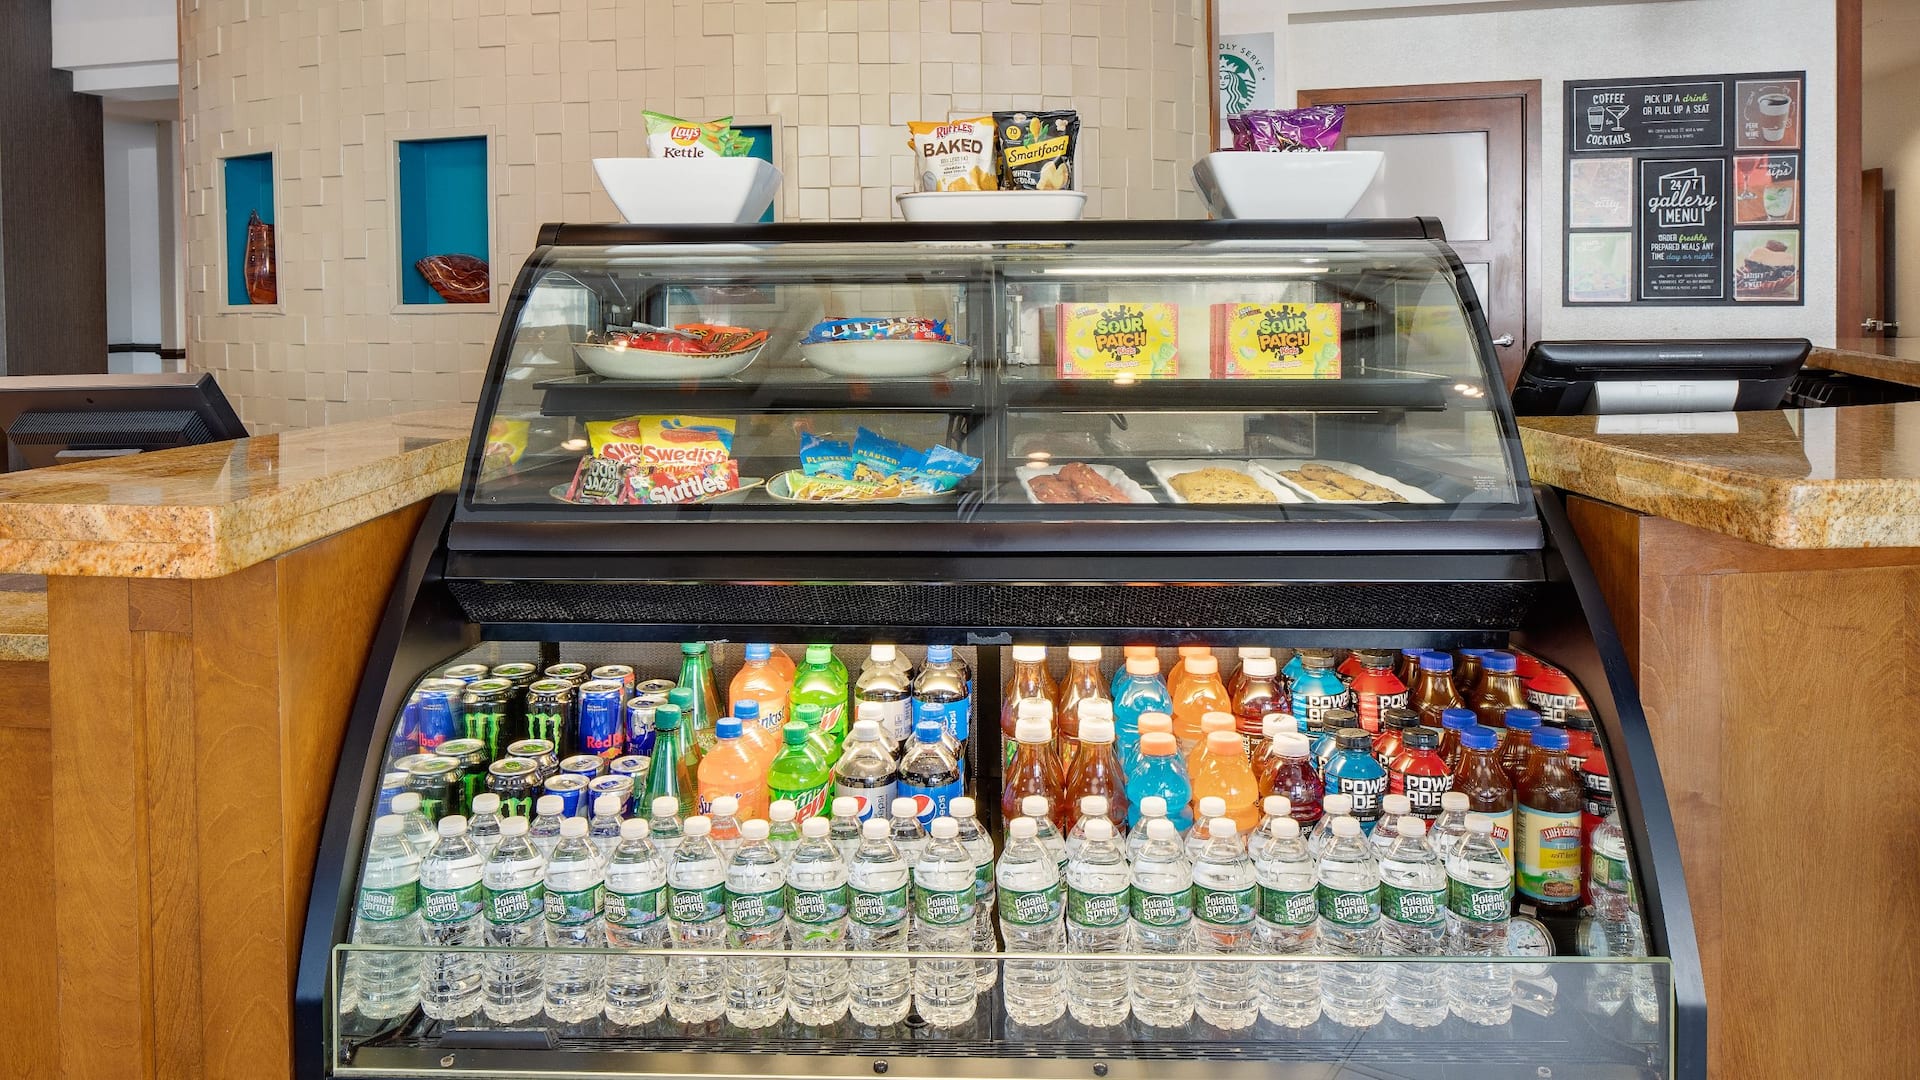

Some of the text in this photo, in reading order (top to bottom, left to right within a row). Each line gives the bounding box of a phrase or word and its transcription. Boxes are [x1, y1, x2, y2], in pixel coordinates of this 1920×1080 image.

[1240, 47, 1265, 72] SERVE
[1592, 93, 1625, 105] COFFEE
[1644, 93, 1709, 104] PICK UP A drink
[1643, 104, 1710, 115] OR PULL UP A SEAT
[673, 126, 700, 140] Lay's
[936, 123, 973, 139] RUFFLES
[1586, 133, 1632, 146] COCKTAILS
[664, 147, 704, 158] Kettle
[924, 139, 983, 157] BAKED
[1008, 141, 1066, 163] Smartfood
[1013, 170, 1031, 178] WHITE
[1765, 168, 1790, 179] sips
[1670, 179, 1698, 191] 24 7
[1648, 181, 1717, 213] gallery
[1666, 208, 1699, 223] MENU
[1658, 233, 1708, 243] ORDER freshly
[1650, 243, 1714, 251] PREPARED MEALS ANY
[1651, 252, 1665, 260] TIME
[1666, 253, 1681, 261] day
[1693, 252, 1714, 262] night
[1097, 317, 1143, 334] SOUR
[1260, 317, 1307, 334] SOUR
[1095, 331, 1147, 352] PATCH
[1258, 331, 1310, 352] PATCH
[642, 445, 728, 463] Swedish
[590, 460, 616, 479] OUR
[650, 475, 728, 503] Skittles
[1309, 692, 1349, 709] POWE
[1380, 691, 1408, 709] POW
[586, 734, 612, 749] Red
[1341, 775, 1388, 795] POWE
[1406, 775, 1454, 791] POWE
[938, 795, 947, 816] epsi
[1354, 794, 1377, 809] DE
[1406, 790, 1441, 807] ADE
[426, 891, 457, 905] Poland
[494, 891, 527, 907] Poland
[673, 892, 702, 905] Poland
[732, 896, 763, 911] Poland
[795, 893, 824, 906] Poland
[855, 894, 883, 907] Poland
[927, 894, 958, 908] Poland
[1015, 894, 1047, 908] Poland
[1085, 896, 1117, 911] Poland
[1142, 895, 1174, 909] Poland
[1204, 893, 1237, 906] Poland
[1285, 893, 1314, 910] Poland
[1334, 894, 1367, 907] Poland
[1400, 892, 1433, 906] Poland
[1471, 891, 1504, 906] Poland
[427, 903, 458, 916] Spring
[496, 900, 528, 919] Spring
[674, 902, 704, 916] Spring
[733, 907, 764, 921] Spring
[796, 903, 825, 917] Spring
[856, 904, 885, 918] Spring
[928, 904, 959, 919] Spring
[1017, 903, 1048, 920] Spring
[1086, 907, 1118, 921] Spring
[1144, 906, 1176, 920] Spring
[1206, 903, 1238, 918] Spring
[1287, 903, 1315, 921] Spring
[1335, 905, 1368, 920] Spring
[1402, 903, 1435, 918] Spring
[1473, 902, 1505, 917] Spring
